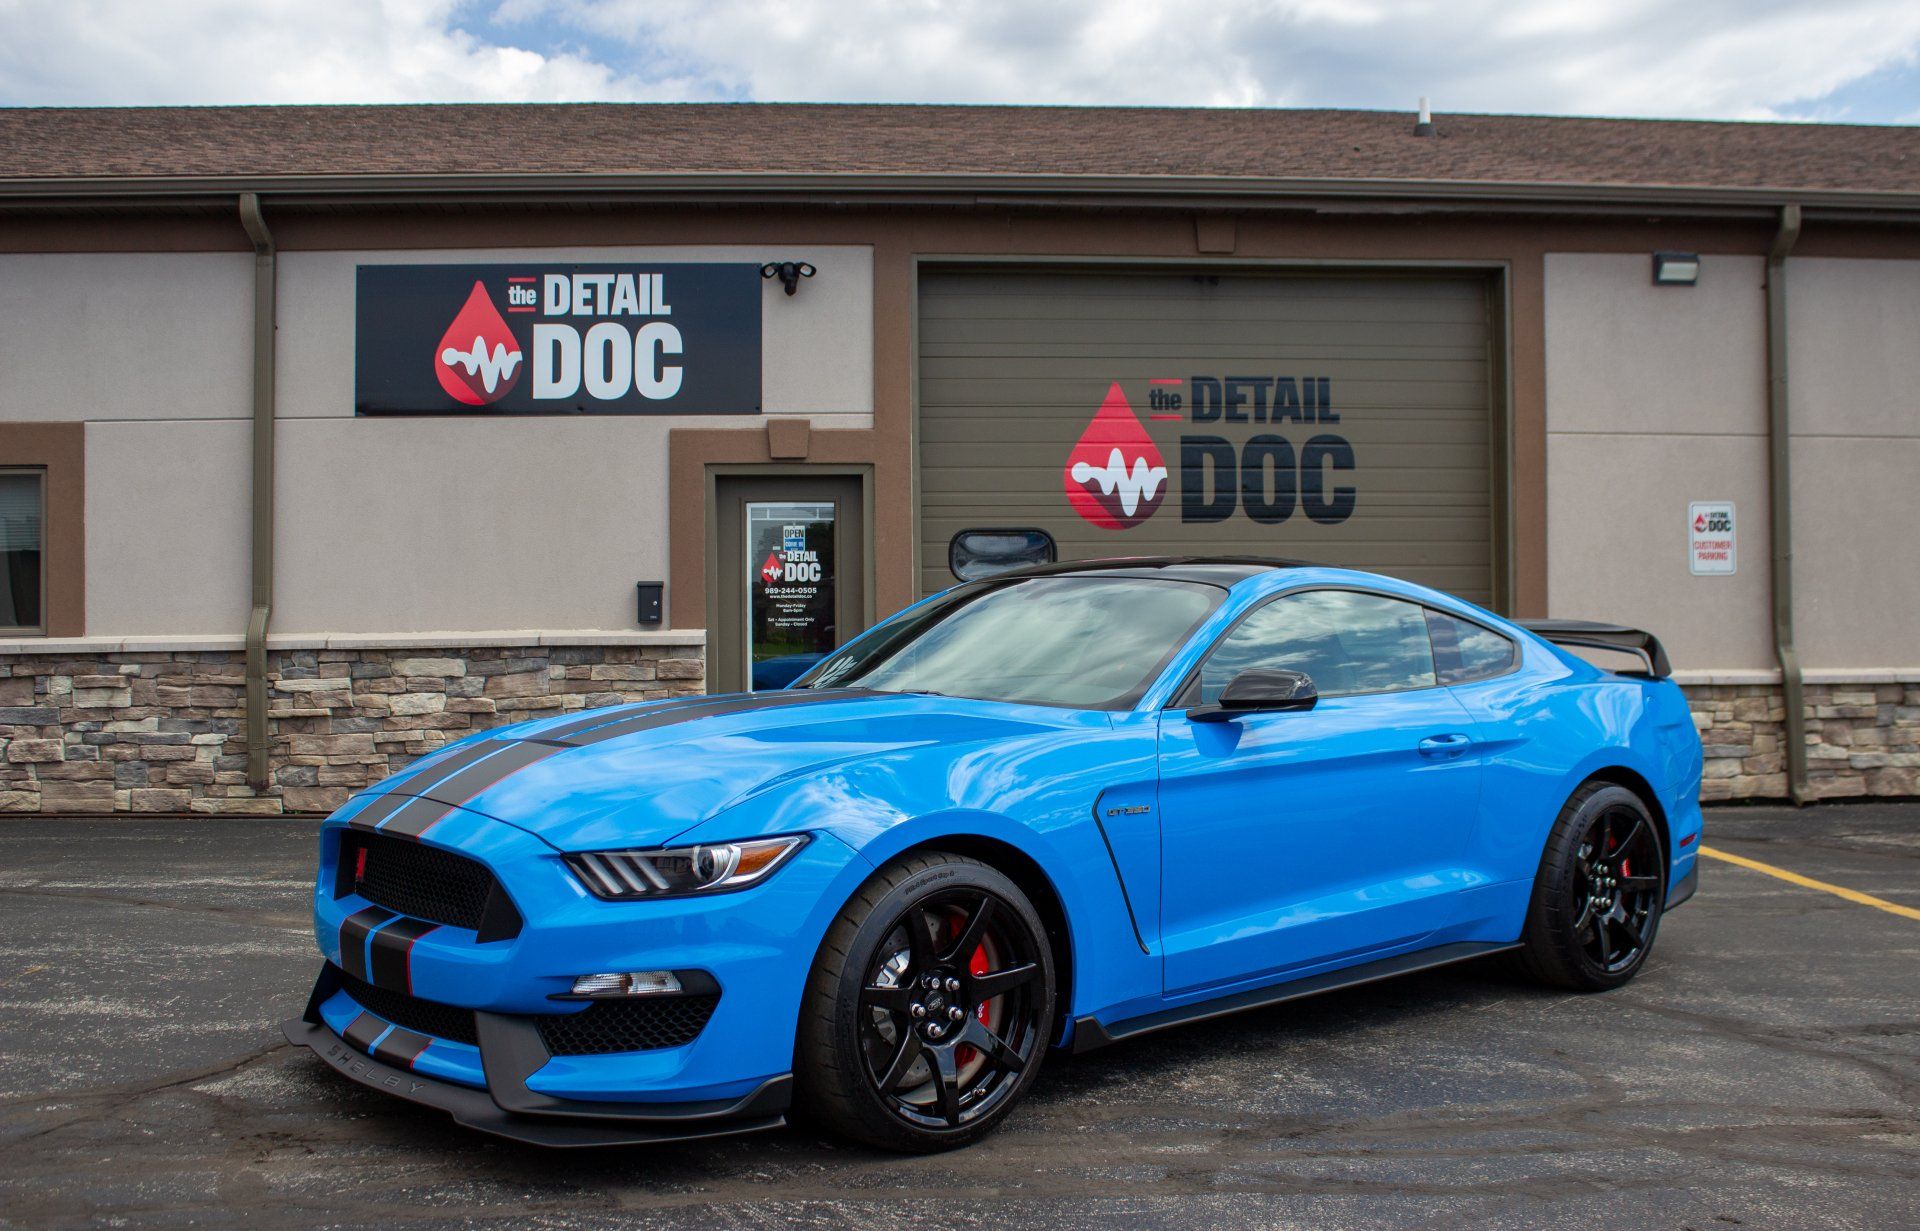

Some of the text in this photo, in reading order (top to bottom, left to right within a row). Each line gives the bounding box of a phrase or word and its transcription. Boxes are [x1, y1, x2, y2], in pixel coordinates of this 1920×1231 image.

[507, 273, 672, 316] the DETAIL
[532, 321, 683, 400] DOC
[1149, 376, 1340, 424] the DETAIL
[1180, 434, 1356, 525] DOC
[784, 529, 804, 538] OPEN
[1708, 520, 1732, 532] DOC
[784, 562, 821, 582] DOC
[787, 551, 818, 562] DETAIL
[327, 1044, 423, 1093] SHELBY
